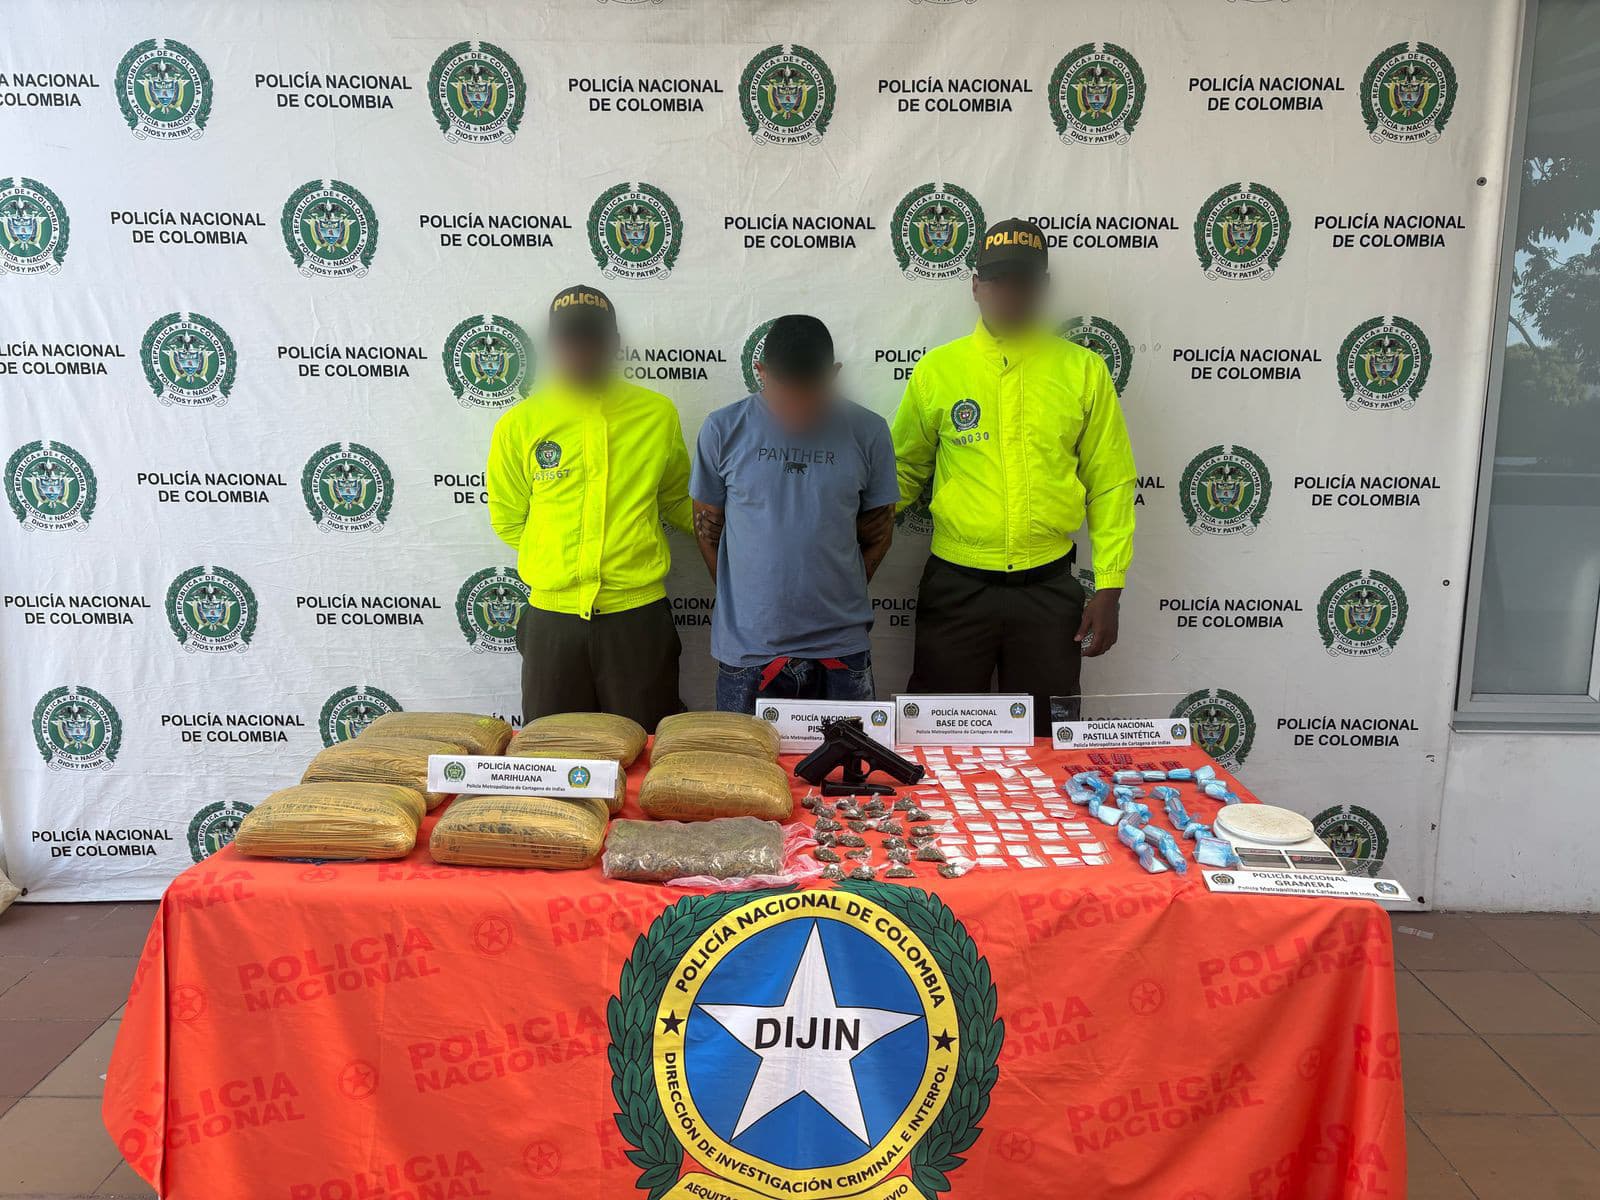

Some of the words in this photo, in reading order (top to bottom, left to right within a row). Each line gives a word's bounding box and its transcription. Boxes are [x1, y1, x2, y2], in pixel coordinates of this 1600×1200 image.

[13, 73, 100, 88] NACIONAL
[255, 71, 322, 89] POLICÍA
[325, 74, 413, 90] NACIONAL
[568, 75, 635, 93] POLICÍA
[638, 78, 724, 93] NACIONAL
[878, 75, 944, 94] POLICÍA
[948, 78, 1033, 93] NACIONAL
[1188, 74, 1255, 92] POLICÍA
[1259, 76, 1345, 92] NACIONAL
[276, 93, 300, 108] DE
[304, 93, 394, 109] COLOMBIA
[589, 97, 612, 112] DE
[615, 97, 705, 112] COLOMBIA
[898, 98, 920, 113] DE
[924, 98, 1013, 113] COLOMBIA
[1207, 97, 1230, 111] DE
[1234, 96, 1324, 111] COLOMBIA
[110, 208, 177, 225] POLICÍA
[180, 211, 266, 226] NACIONAL
[419, 212, 485, 229] POLICÍA
[488, 215, 573, 229] NACIONAL
[724, 213, 789, 230] POLICÍA
[792, 216, 876, 230] NACIONAL
[1095, 216, 1180, 230] NACIONAL
[1314, 212, 1380, 230] POLICÍA
[1383, 215, 1466, 229] NACIONAL
[132, 230, 155, 244] DE
[159, 230, 248, 245] COLOMBIA
[440, 233, 462, 247] DE
[466, 233, 554, 247] COLOMBIA
[744, 235, 766, 249] DE
[770, 235, 857, 249] COLOMBIA
[985, 231, 1042, 251] POLICIA
[1072, 234, 1159, 249] COLOMBIA
[1332, 234, 1355, 248] DE
[1359, 233, 1446, 248] COLOMBIA
[554, 293, 609, 312] POLICIA
[41, 343, 126, 358] NACIONAL
[277, 343, 342, 360] POLICÍA
[345, 346, 428, 360] NACIONAL
[645, 348, 727, 363] NACIONAL
[1172, 345, 1236, 362] POLICÍA
[1239, 348, 1322, 362] NACIONAL
[22, 361, 108, 375] COLOMBIA
[298, 364, 321, 377] DE
[324, 364, 410, 378] COLOMBIA
[623, 366, 709, 381] COLOMBIA
[1191, 366, 1213, 380] DE
[1216, 366, 1302, 380] COLOMBIA
[758, 448, 835, 465] PANTHER
[137, 470, 202, 486] POLICÍA
[204, 473, 288, 486] NACIONAL
[1294, 473, 1357, 490] POLICÍA
[1360, 476, 1441, 490] NACIONAL
[158, 490, 180, 503] DE
[184, 490, 270, 503] COLOMBIA
[1311, 493, 1333, 507] DE
[1337, 493, 1421, 507] COLOMBIA
[4, 593, 66, 608] POLICÍA
[69, 595, 151, 608] NACIONAL
[296, 593, 358, 609] POLICÍA
[361, 596, 442, 609] NACIONAL
[1159, 596, 1221, 612] POLICÍA
[1224, 599, 1304, 612] NACIONAL
[24, 612, 46, 625] DE
[49, 612, 134, 625] COLOMBIA
[316, 613, 337, 625] DE
[341, 612, 424, 625] COLOMBIA
[1176, 615, 1198, 628] DE
[1201, 615, 1284, 628] COLOMBIA
[791, 714, 819, 722] POLICÍA
[931, 708, 959, 716] POLICÍA
[161, 714, 223, 727] POLICÍA
[226, 714, 305, 727] NACIONAL
[936, 719, 956, 727] BASE
[958, 719, 968, 727] DE
[970, 719, 993, 727] COCA
[1087, 721, 1115, 730] POLICÍA
[1276, 715, 1337, 731] POLICÍA
[1340, 718, 1419, 731] NACIONAL
[181, 730, 203, 743] DE
[206, 730, 289, 743] COLOMBIA
[1083, 732, 1120, 741] PASTILLA
[1121, 730, 1161, 739] SINTÉTICA
[1293, 734, 1315, 747] DE
[1318, 734, 1400, 747] COLOMBIA
[477, 762, 511, 770] POLICÍA
[513, 764, 557, 772] NACIONAL
[490, 773, 543, 782] MARIHUANA
[32, 827, 92, 843] POLICÍA
[94, 829, 174, 842] NACIONAL
[50, 845, 72, 858] DE
[75, 844, 158, 857] COLOMBIA
[1252, 872, 1292, 880] POLICÍA
[1294, 873, 1348, 883] NACIONAL
[1274, 880, 1335, 889] GRAMERA
[675, 928, 737, 993] POLICÍA
[736, 893, 841, 930] NACIONAL
[845, 901, 873, 923] DE
[875, 917, 946, 1009] COLOMBIA
[1198, 919, 1388, 986] POLICIA
[237, 928, 434, 990] POLICIA
[244, 956, 440, 1012] NACIONAL
[1204, 945, 1390, 1009] NACIONAL
[754, 1016, 861, 1051] DIJIN
[664, 1052, 699, 1142] DIRECCIÓN
[906, 1063, 949, 1131] INTERPOL
[901, 1130, 912, 1143] E
[697, 1139, 716, 1157] DE
[715, 1152, 833, 1193] INVESTIGACIÓN
[836, 1145, 904, 1188] CRIMINAL
